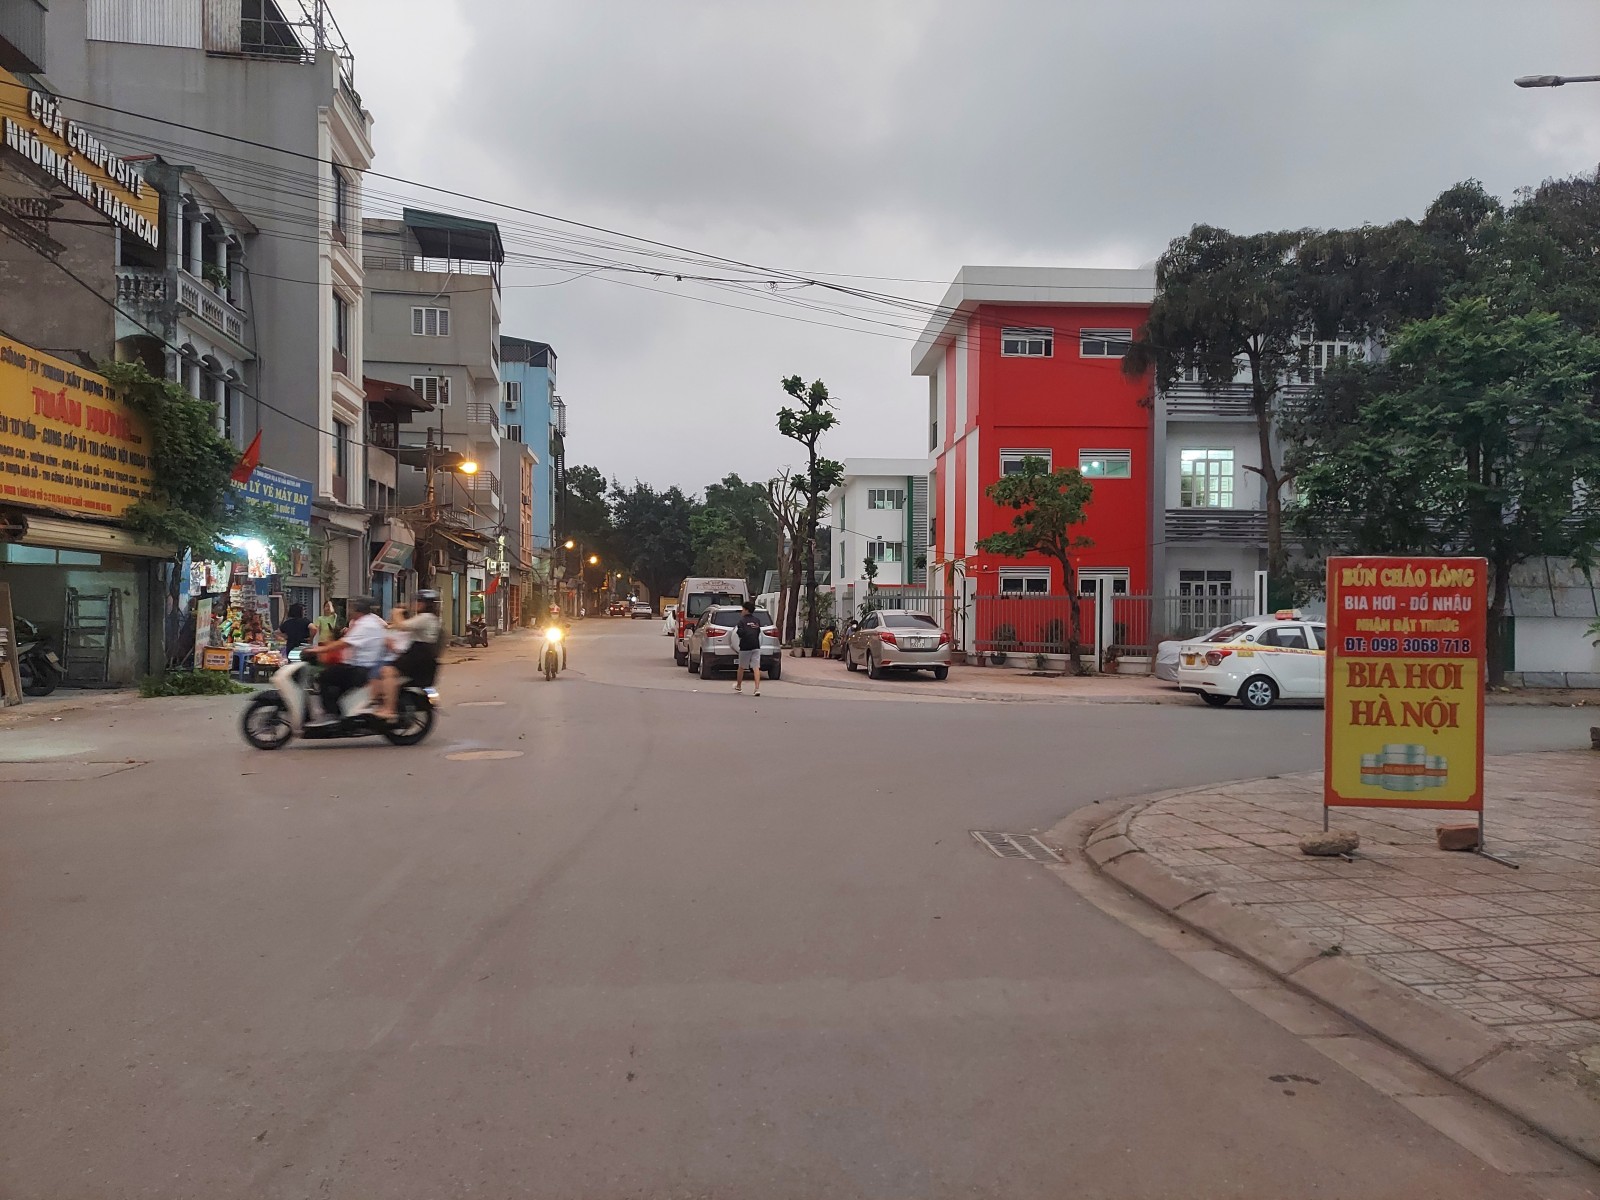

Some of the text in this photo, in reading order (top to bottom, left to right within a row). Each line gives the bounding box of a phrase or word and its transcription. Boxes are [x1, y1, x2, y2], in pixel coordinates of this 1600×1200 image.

[31, 91, 144, 200] CỬA COMPOSITE
[6, 117, 56, 177] NHÔM
[137, 214, 159, 248] CAO
[32, 387, 81, 427] TUẤN
[78, 435, 87, 453] VÀ
[250, 479, 261, 494] LÝ
[275, 487, 292, 502] MÁY
[294, 493, 309, 506] BAY
[1342, 563, 1475, 587] BÚN CHÁO LÒNG
[1345, 595, 1369, 610] BIA
[1373, 595, 1396, 610] HƠI
[1432, 593, 1472, 614] NHẬU
[1356, 616, 1391, 634] NHẬN
[1420, 616, 1460, 632] TRƯỚC
[1345, 637, 1471, 653] ĐT: 098 3068 718
[1346, 662, 1464, 689] BIA HƠI
[1349, 693, 1459, 735] HÀ NỘI
